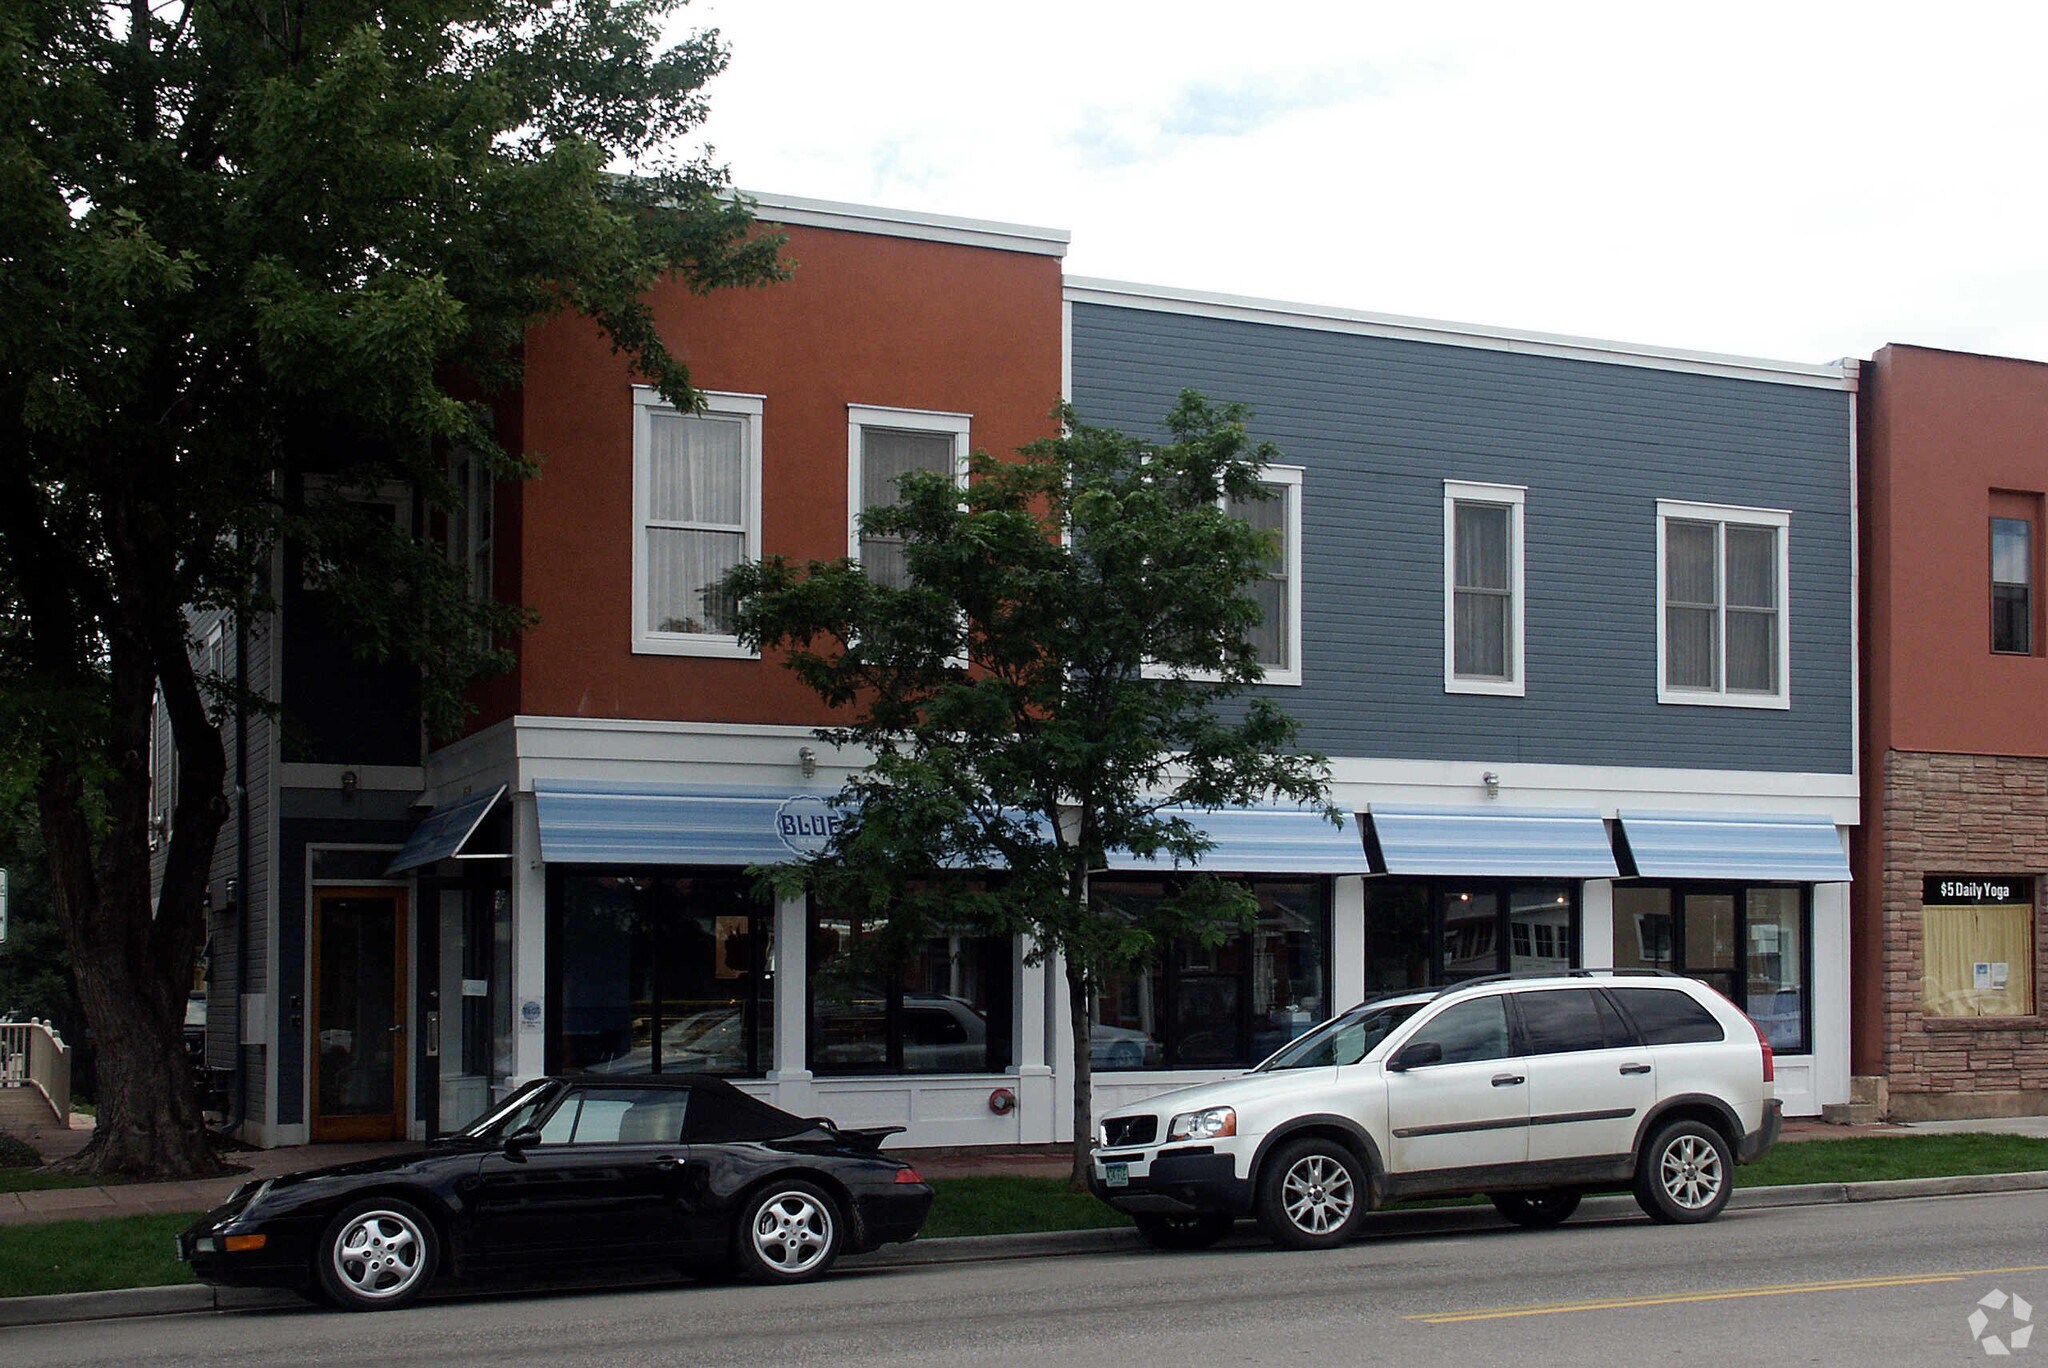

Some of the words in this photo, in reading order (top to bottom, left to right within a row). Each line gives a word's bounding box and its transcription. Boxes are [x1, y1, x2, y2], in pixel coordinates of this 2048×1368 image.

[781, 815, 839, 836] BLUE
[1940, 881, 1954, 897] $5
[1955, 881, 1982, 900] Daily
[1983, 882, 2010, 900] Yoga
